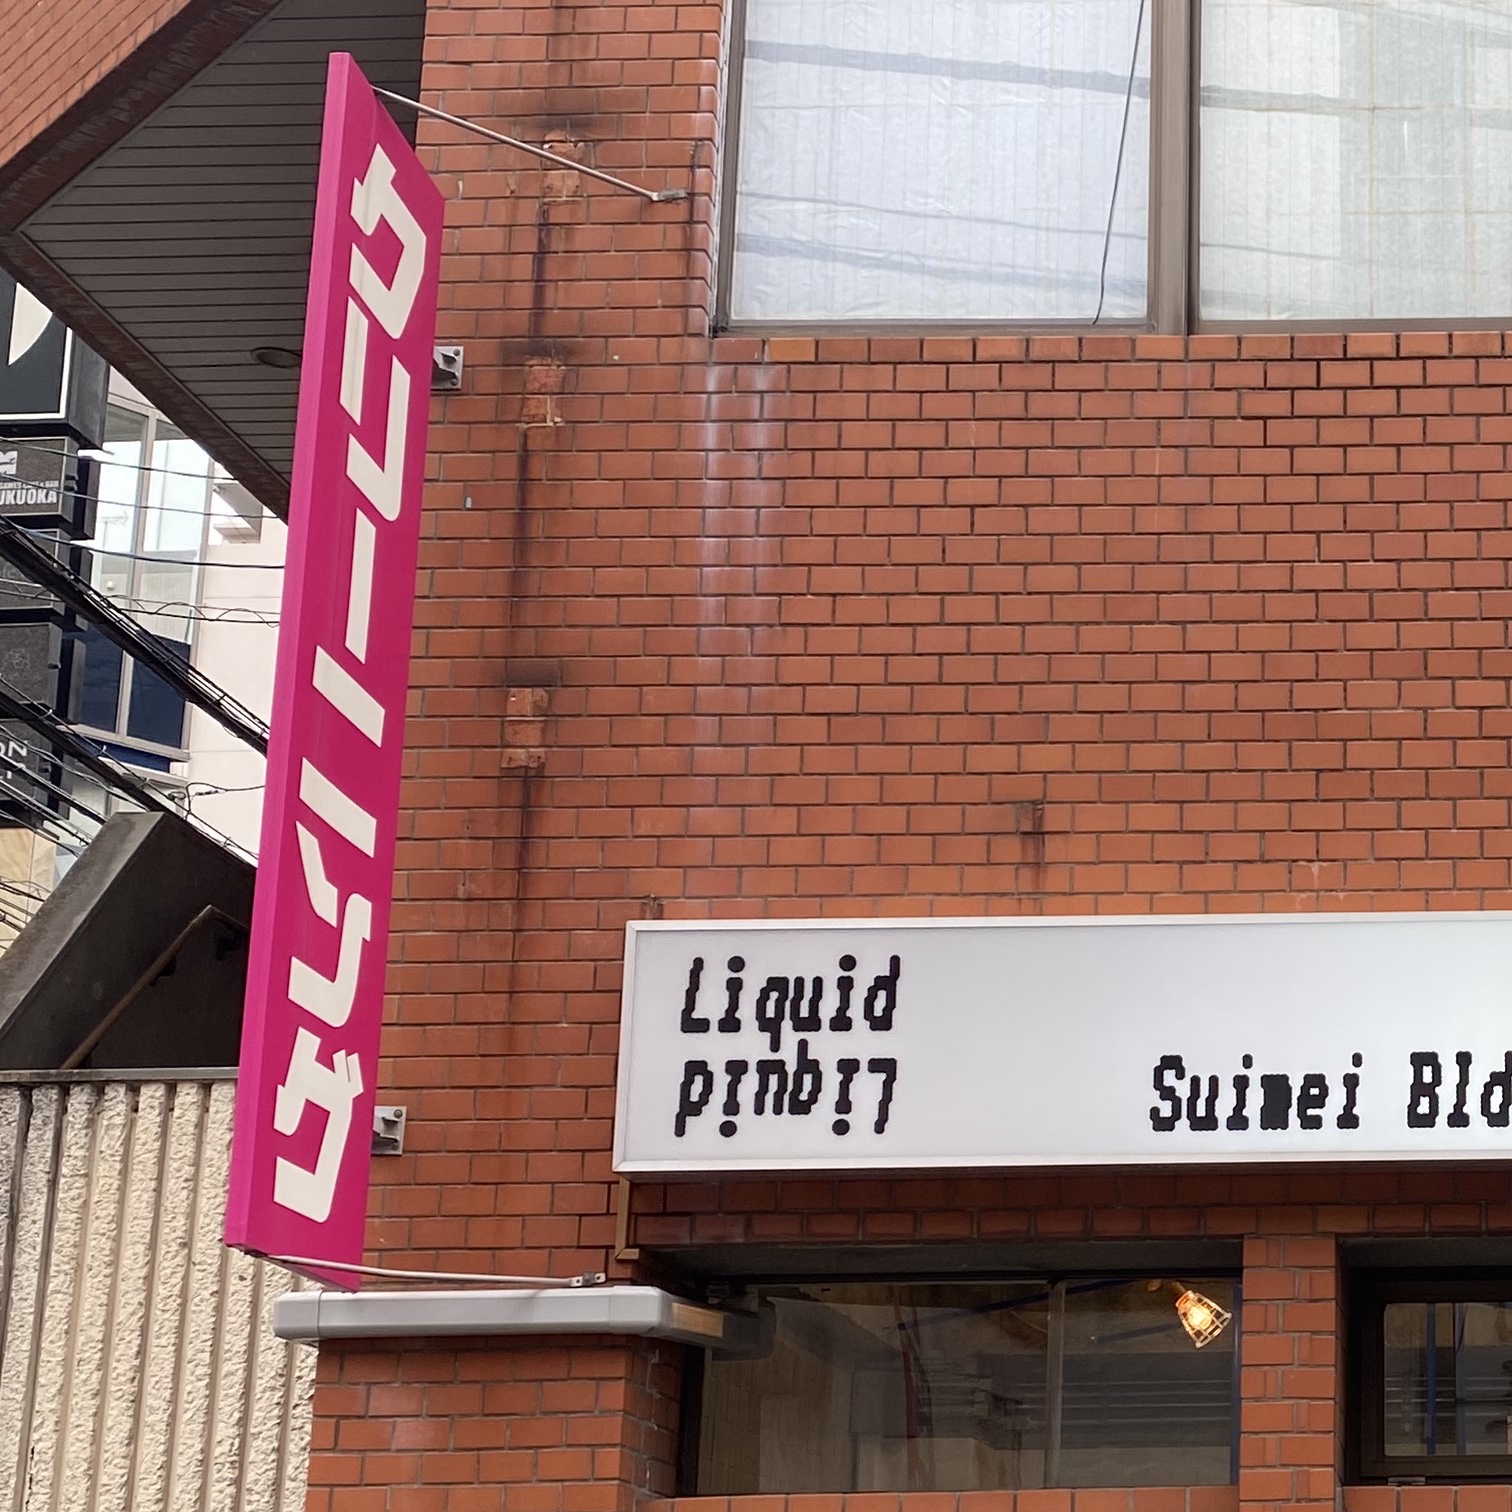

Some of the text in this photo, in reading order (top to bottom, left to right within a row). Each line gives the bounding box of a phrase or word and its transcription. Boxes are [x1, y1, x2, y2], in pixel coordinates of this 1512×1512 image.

[273, 143, 427, 1224] クリーニング
[681, 955, 900, 1052] Liquid
